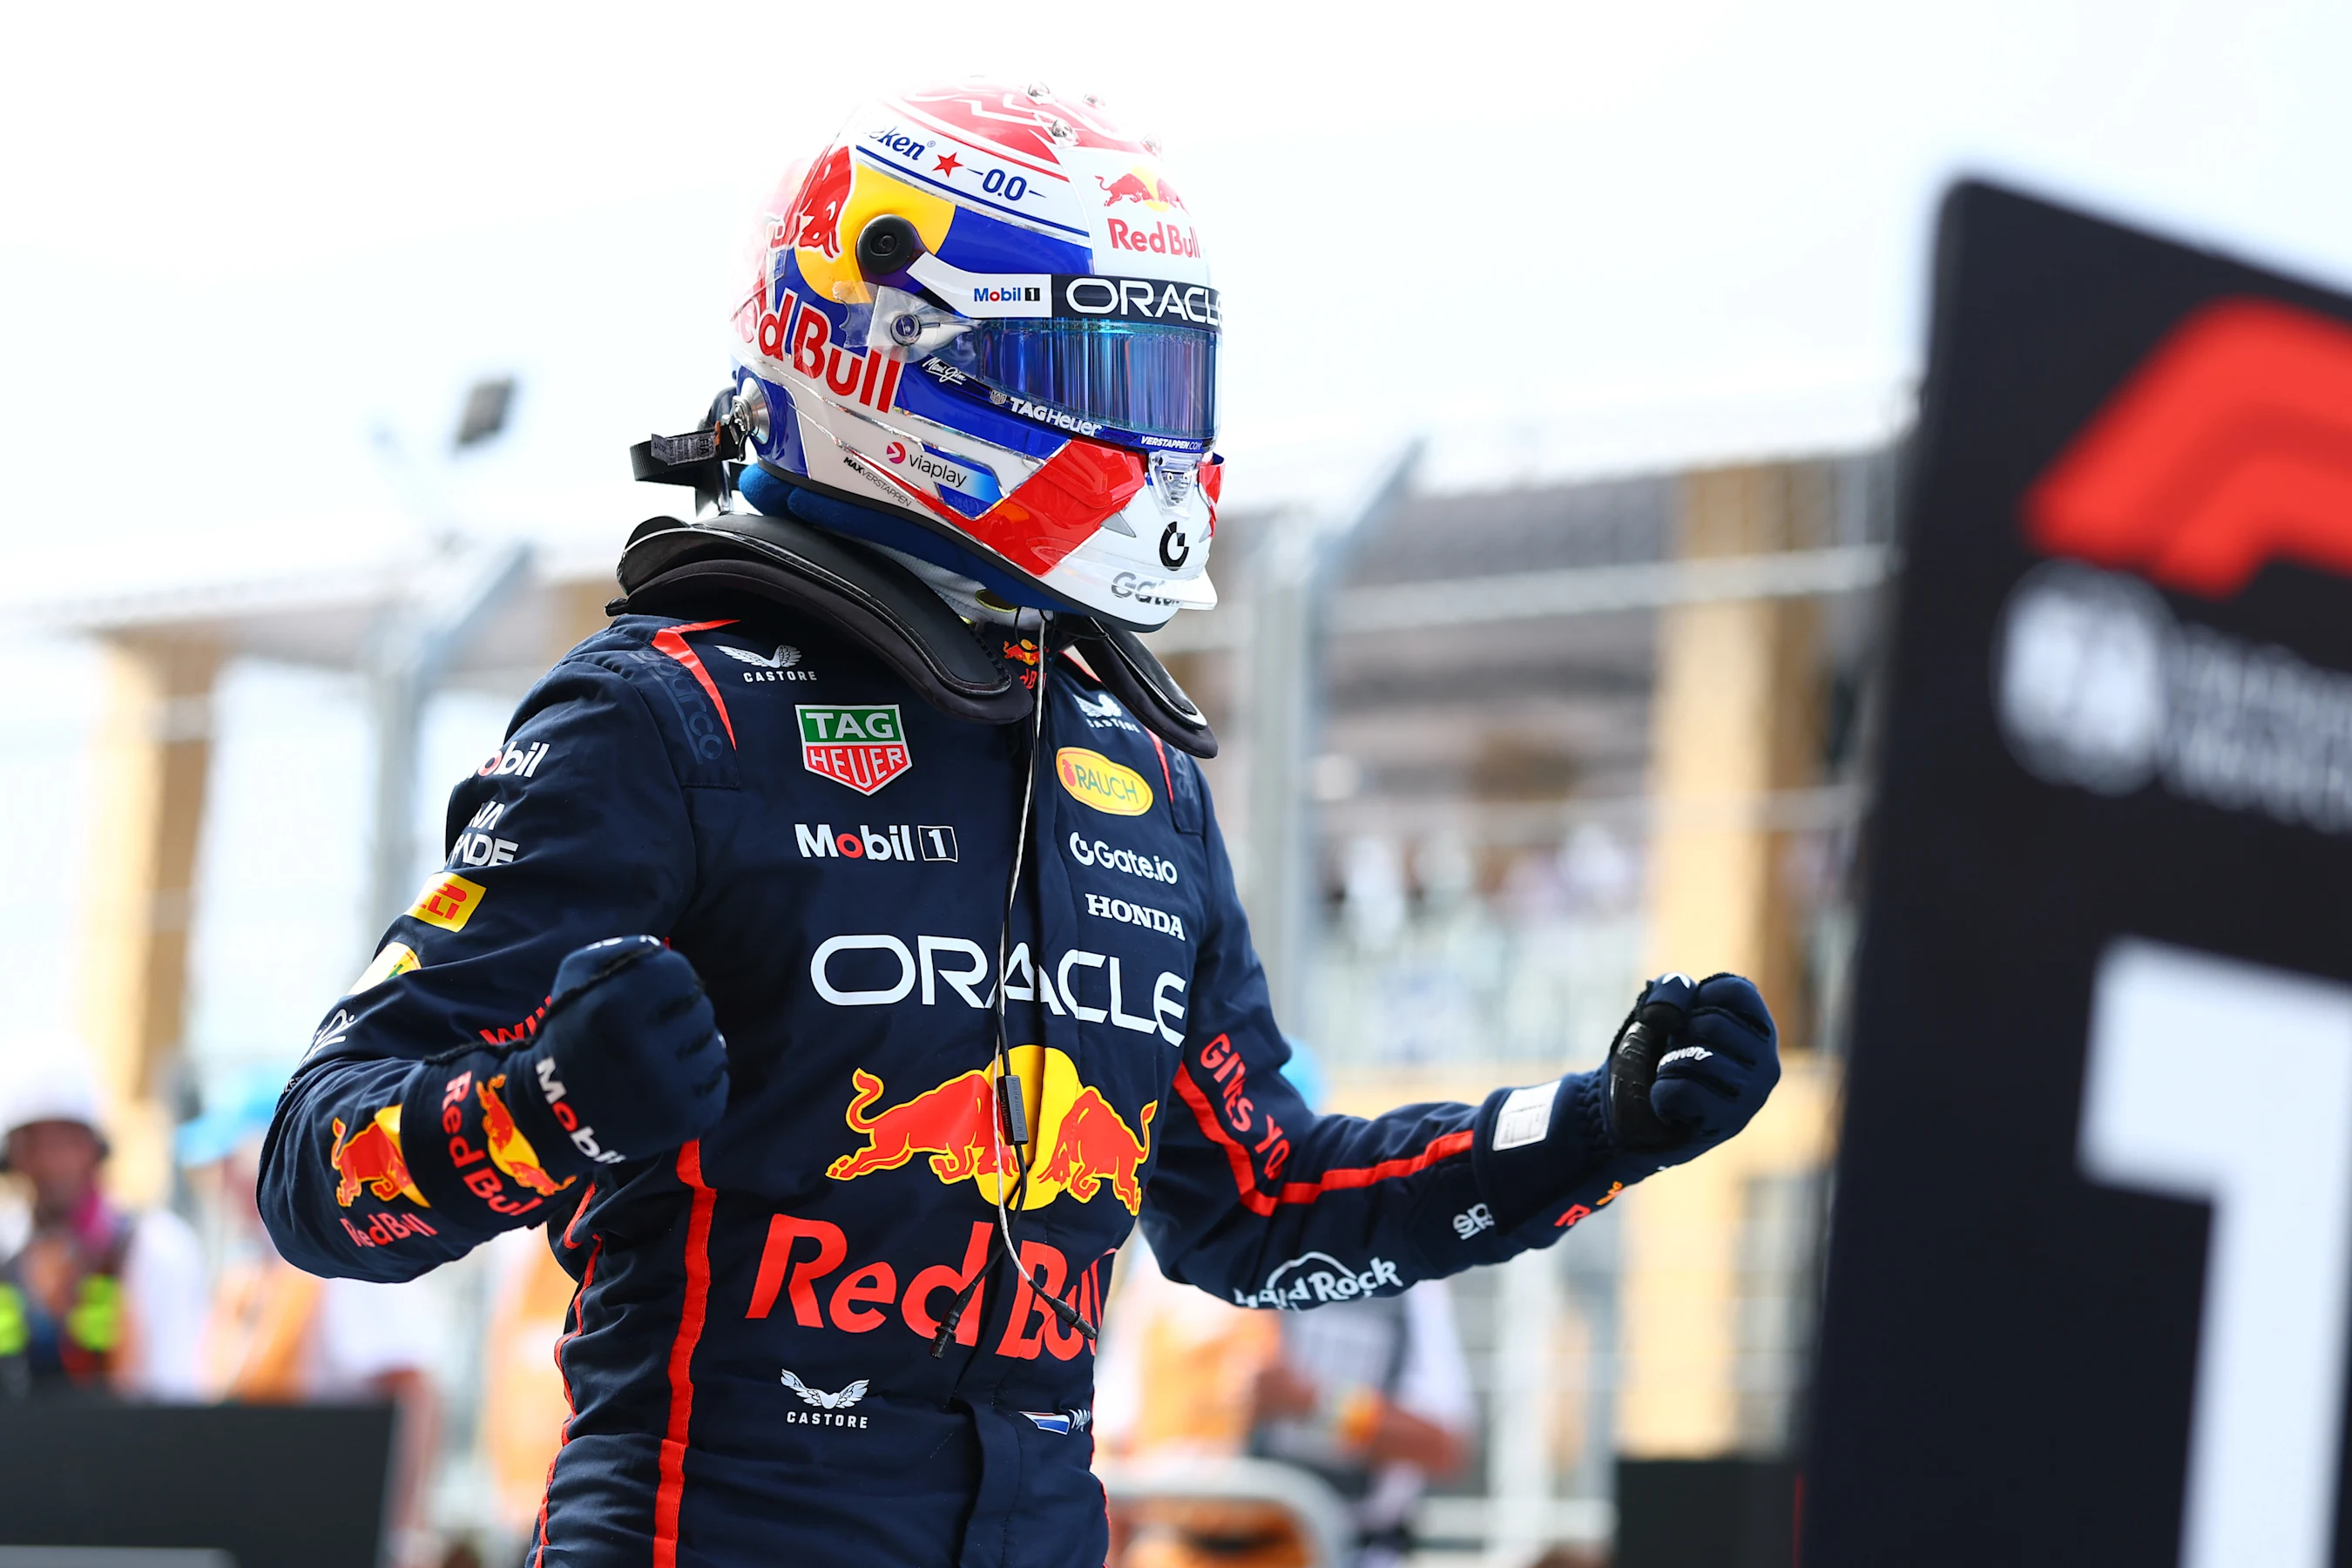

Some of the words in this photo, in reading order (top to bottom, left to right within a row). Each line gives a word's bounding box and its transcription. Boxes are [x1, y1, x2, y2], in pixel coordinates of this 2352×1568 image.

[1107, 218, 1166, 253] Red
[1166, 223, 1200, 259] Bull
[974, 287, 1021, 302] Mobil
[1026, 288, 1039, 301] 1
[793, 306, 901, 414] Bull
[922, 356, 946, 375] Maui
[939, 366, 967, 386] Jim
[1010, 396, 1047, 422] TAG
[1047, 410, 1103, 436] Heuer
[909, 454, 967, 488] viaplay
[742, 670, 817, 683] CASTORE
[806, 712, 894, 740] TAG
[467, 740, 551, 780] obil
[810, 747, 904, 791] HEUER
[1075, 763, 1139, 805] RAUCH
[794, 823, 916, 862] Mobil
[923, 828, 955, 860] 1
[1092, 837, 1179, 885] Gate.io
[1085, 893, 1186, 942] HONDA
[809, 934, 1186, 1048] ORACLE
[442, 1071, 486, 1169] Red
[535, 1057, 626, 1164] Mobil
[339, 1218, 395, 1248] Red
[745, 1213, 994, 1347] Red
[1307, 1256, 1404, 1302] Rock
[786, 1410, 868, 1429] CASTORE
